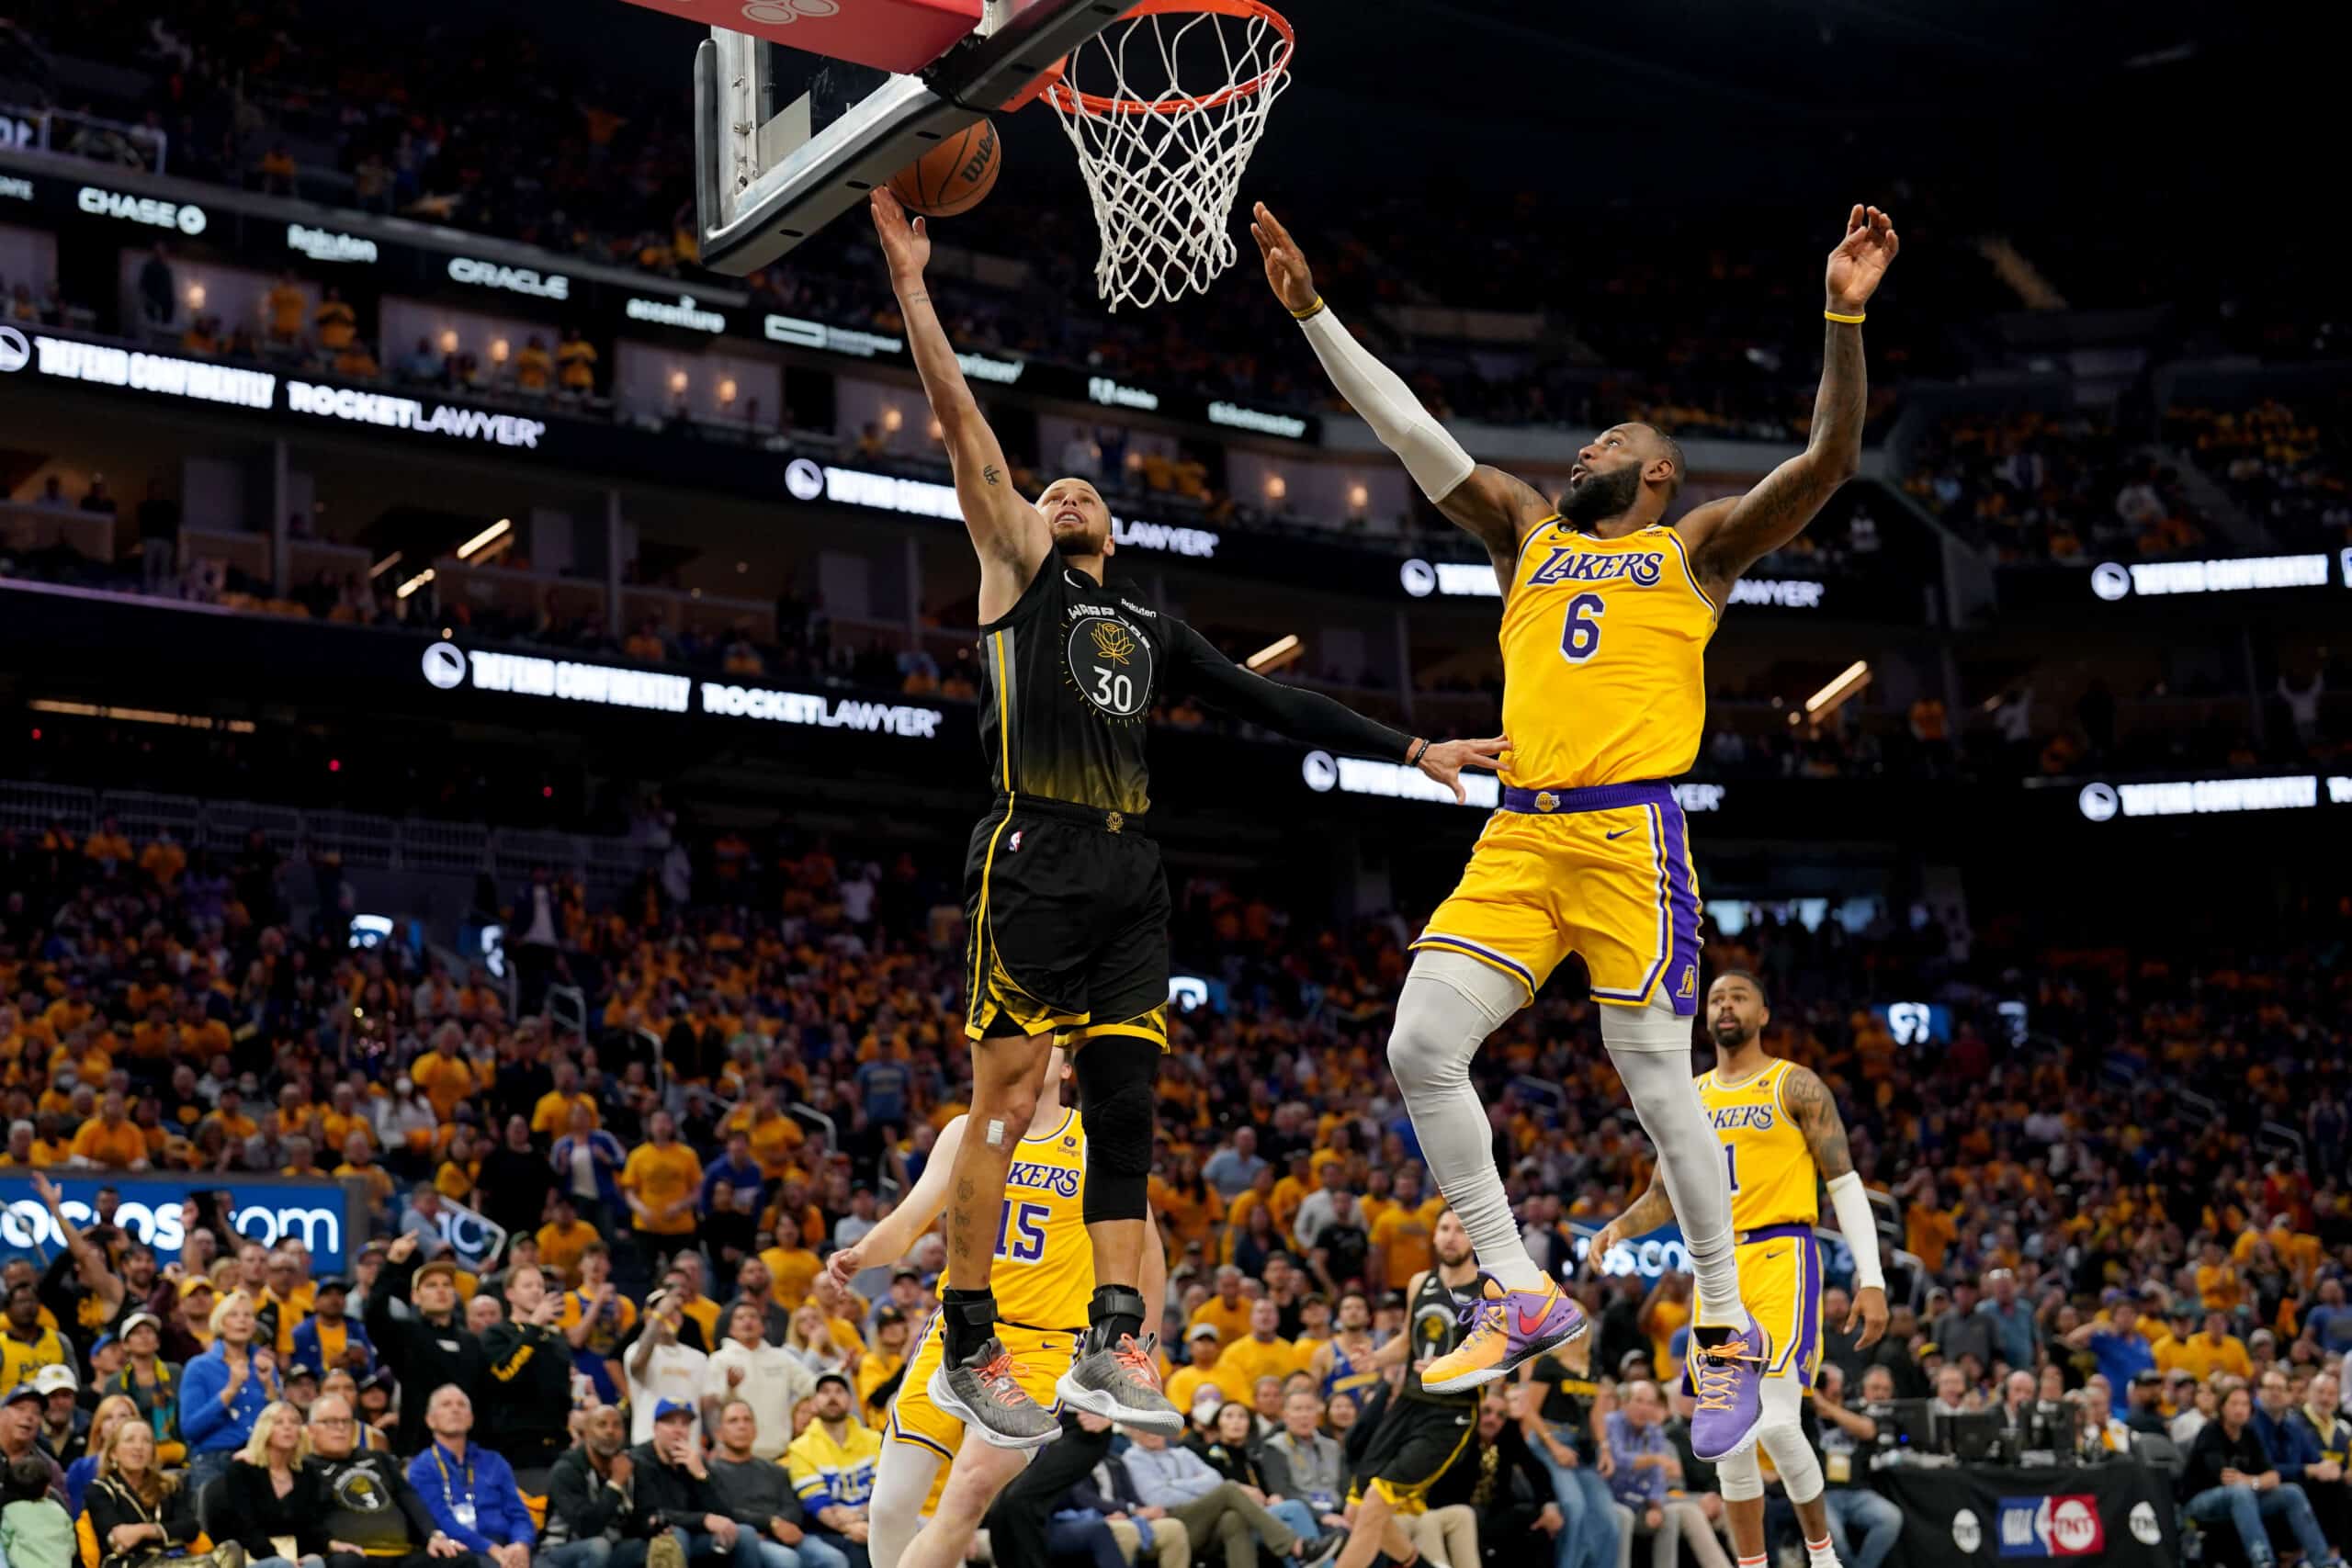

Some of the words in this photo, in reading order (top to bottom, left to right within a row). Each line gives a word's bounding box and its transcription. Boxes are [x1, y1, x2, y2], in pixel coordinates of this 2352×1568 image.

[77, 186, 177, 229] CHASE
[447, 257, 569, 300] ORACLE
[1527, 547, 1664, 588] LAKERS
[1120, 598, 1157, 618] Rakuten
[1559, 592, 1606, 663] 6
[1091, 664, 1133, 713] 30
[1707, 1102, 1775, 1132] KERS
[1006, 1160, 1081, 1199] KERS
[993, 1198, 1052, 1266] 15
[2056, 1516, 2097, 1536] TNT
